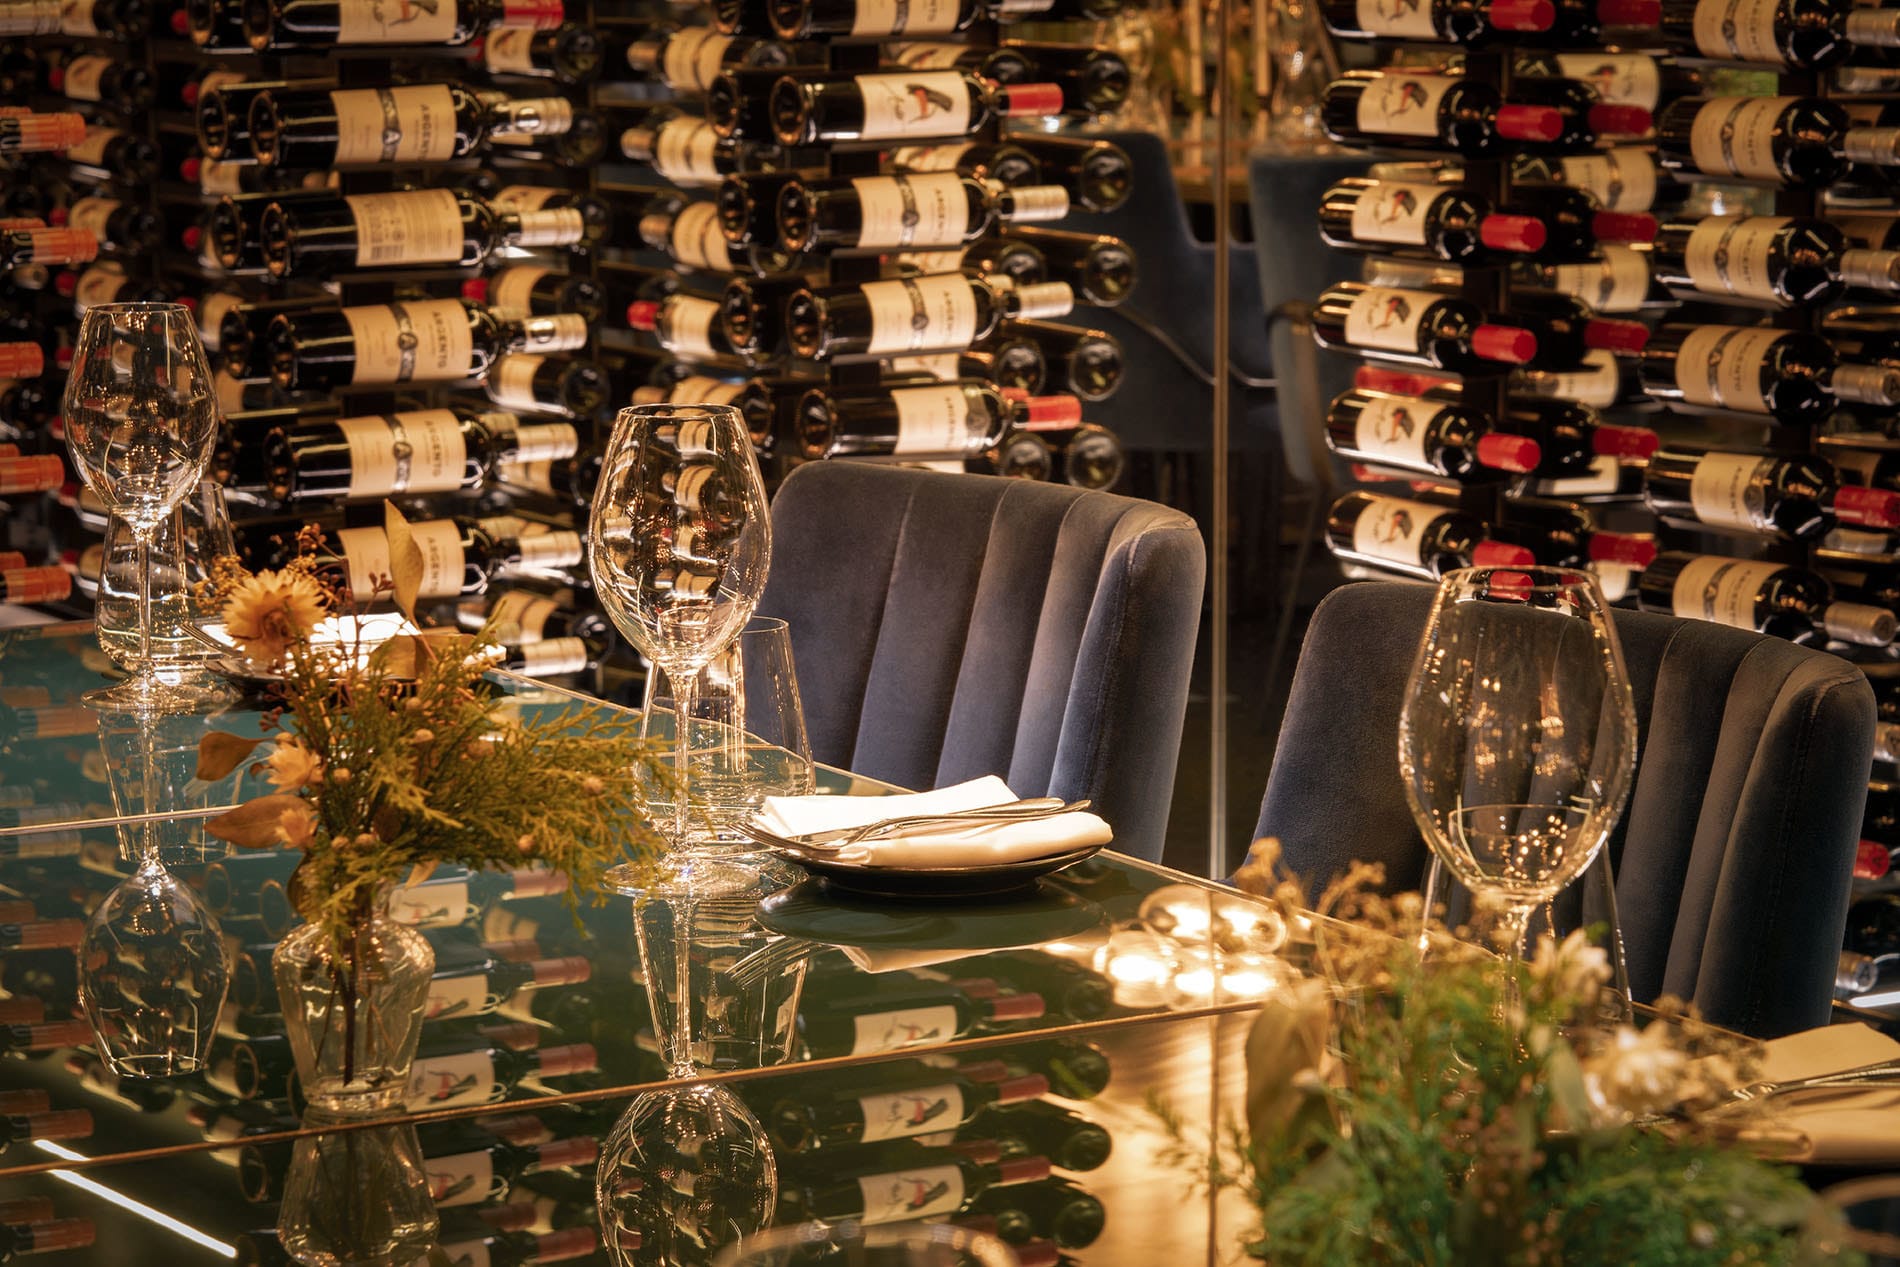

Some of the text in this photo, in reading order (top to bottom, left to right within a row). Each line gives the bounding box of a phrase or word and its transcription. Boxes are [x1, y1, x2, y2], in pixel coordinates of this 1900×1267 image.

[1743, 228, 1758, 287] ARGENT
[432, 311, 447, 369] ARGENTO
[425, 420, 442, 477] ARGENTO
